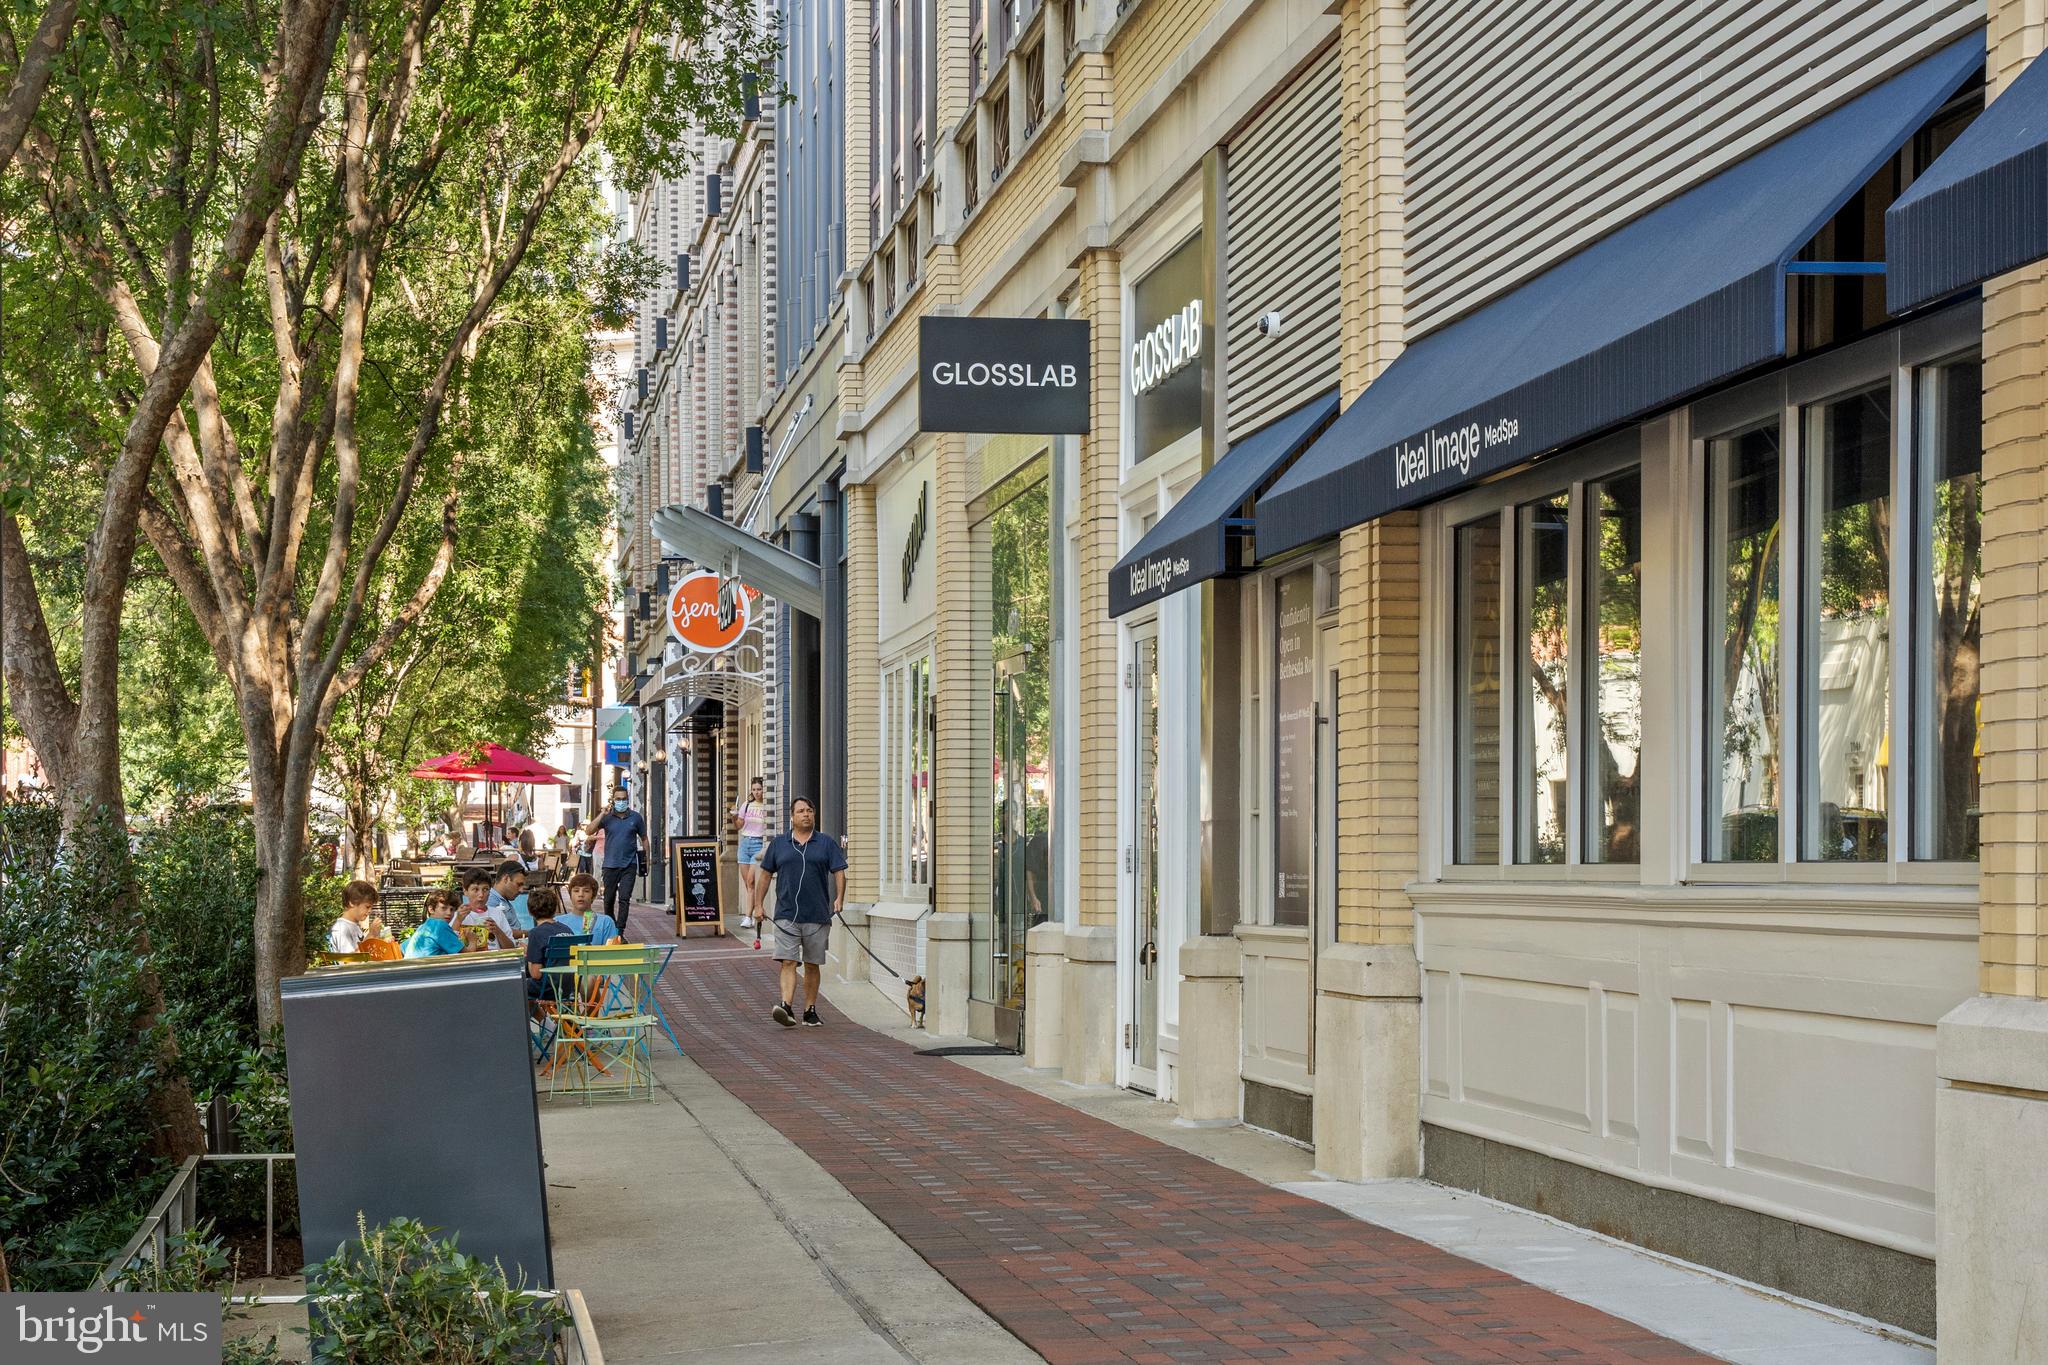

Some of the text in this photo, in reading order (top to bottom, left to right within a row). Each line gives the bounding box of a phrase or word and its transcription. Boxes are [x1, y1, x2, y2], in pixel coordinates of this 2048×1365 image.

[1131, 299, 1202, 396] GLOSSLAB
[932, 362, 1077, 387] GLOSSLAB
[1395, 418, 1518, 489] Ideal Image MedSpa
[1130, 557, 1190, 596] Ideal Image MedSpa
[1280, 603, 1310, 629] Confidently
[1280, 632, 1301, 657] Open in
[1280, 657, 1303, 680] Bethesda
[686, 860, 710, 871] Wedding
